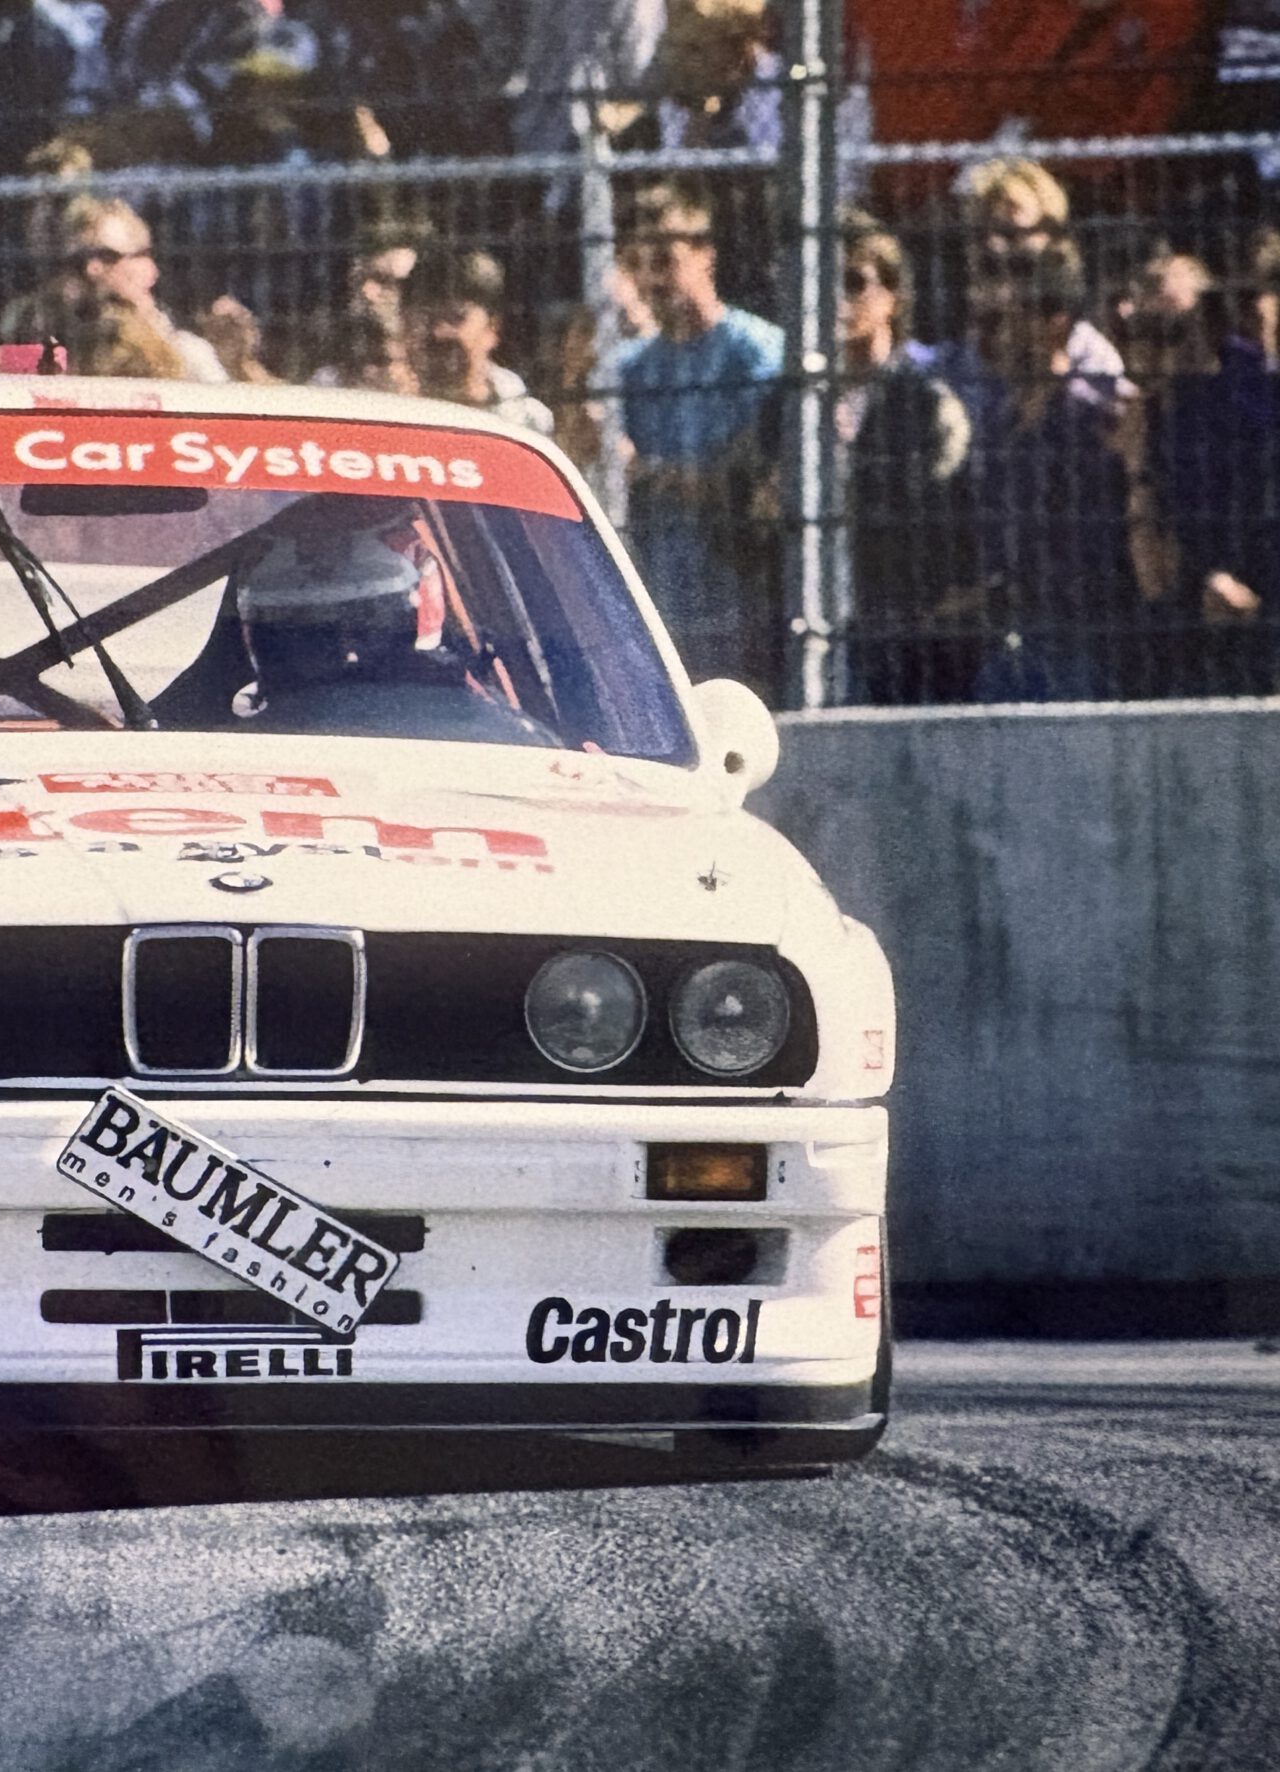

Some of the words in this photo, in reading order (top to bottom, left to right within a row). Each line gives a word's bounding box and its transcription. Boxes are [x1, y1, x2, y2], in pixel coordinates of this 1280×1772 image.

[14, 429, 154, 472] Car
[169, 431, 484, 489] Systems
[62, 1152, 178, 1227] men's
[79, 1094, 388, 1310] BÄUMLER
[117, 1329, 355, 1380] PIRELLI
[526, 1297, 764, 1364] Castrol
